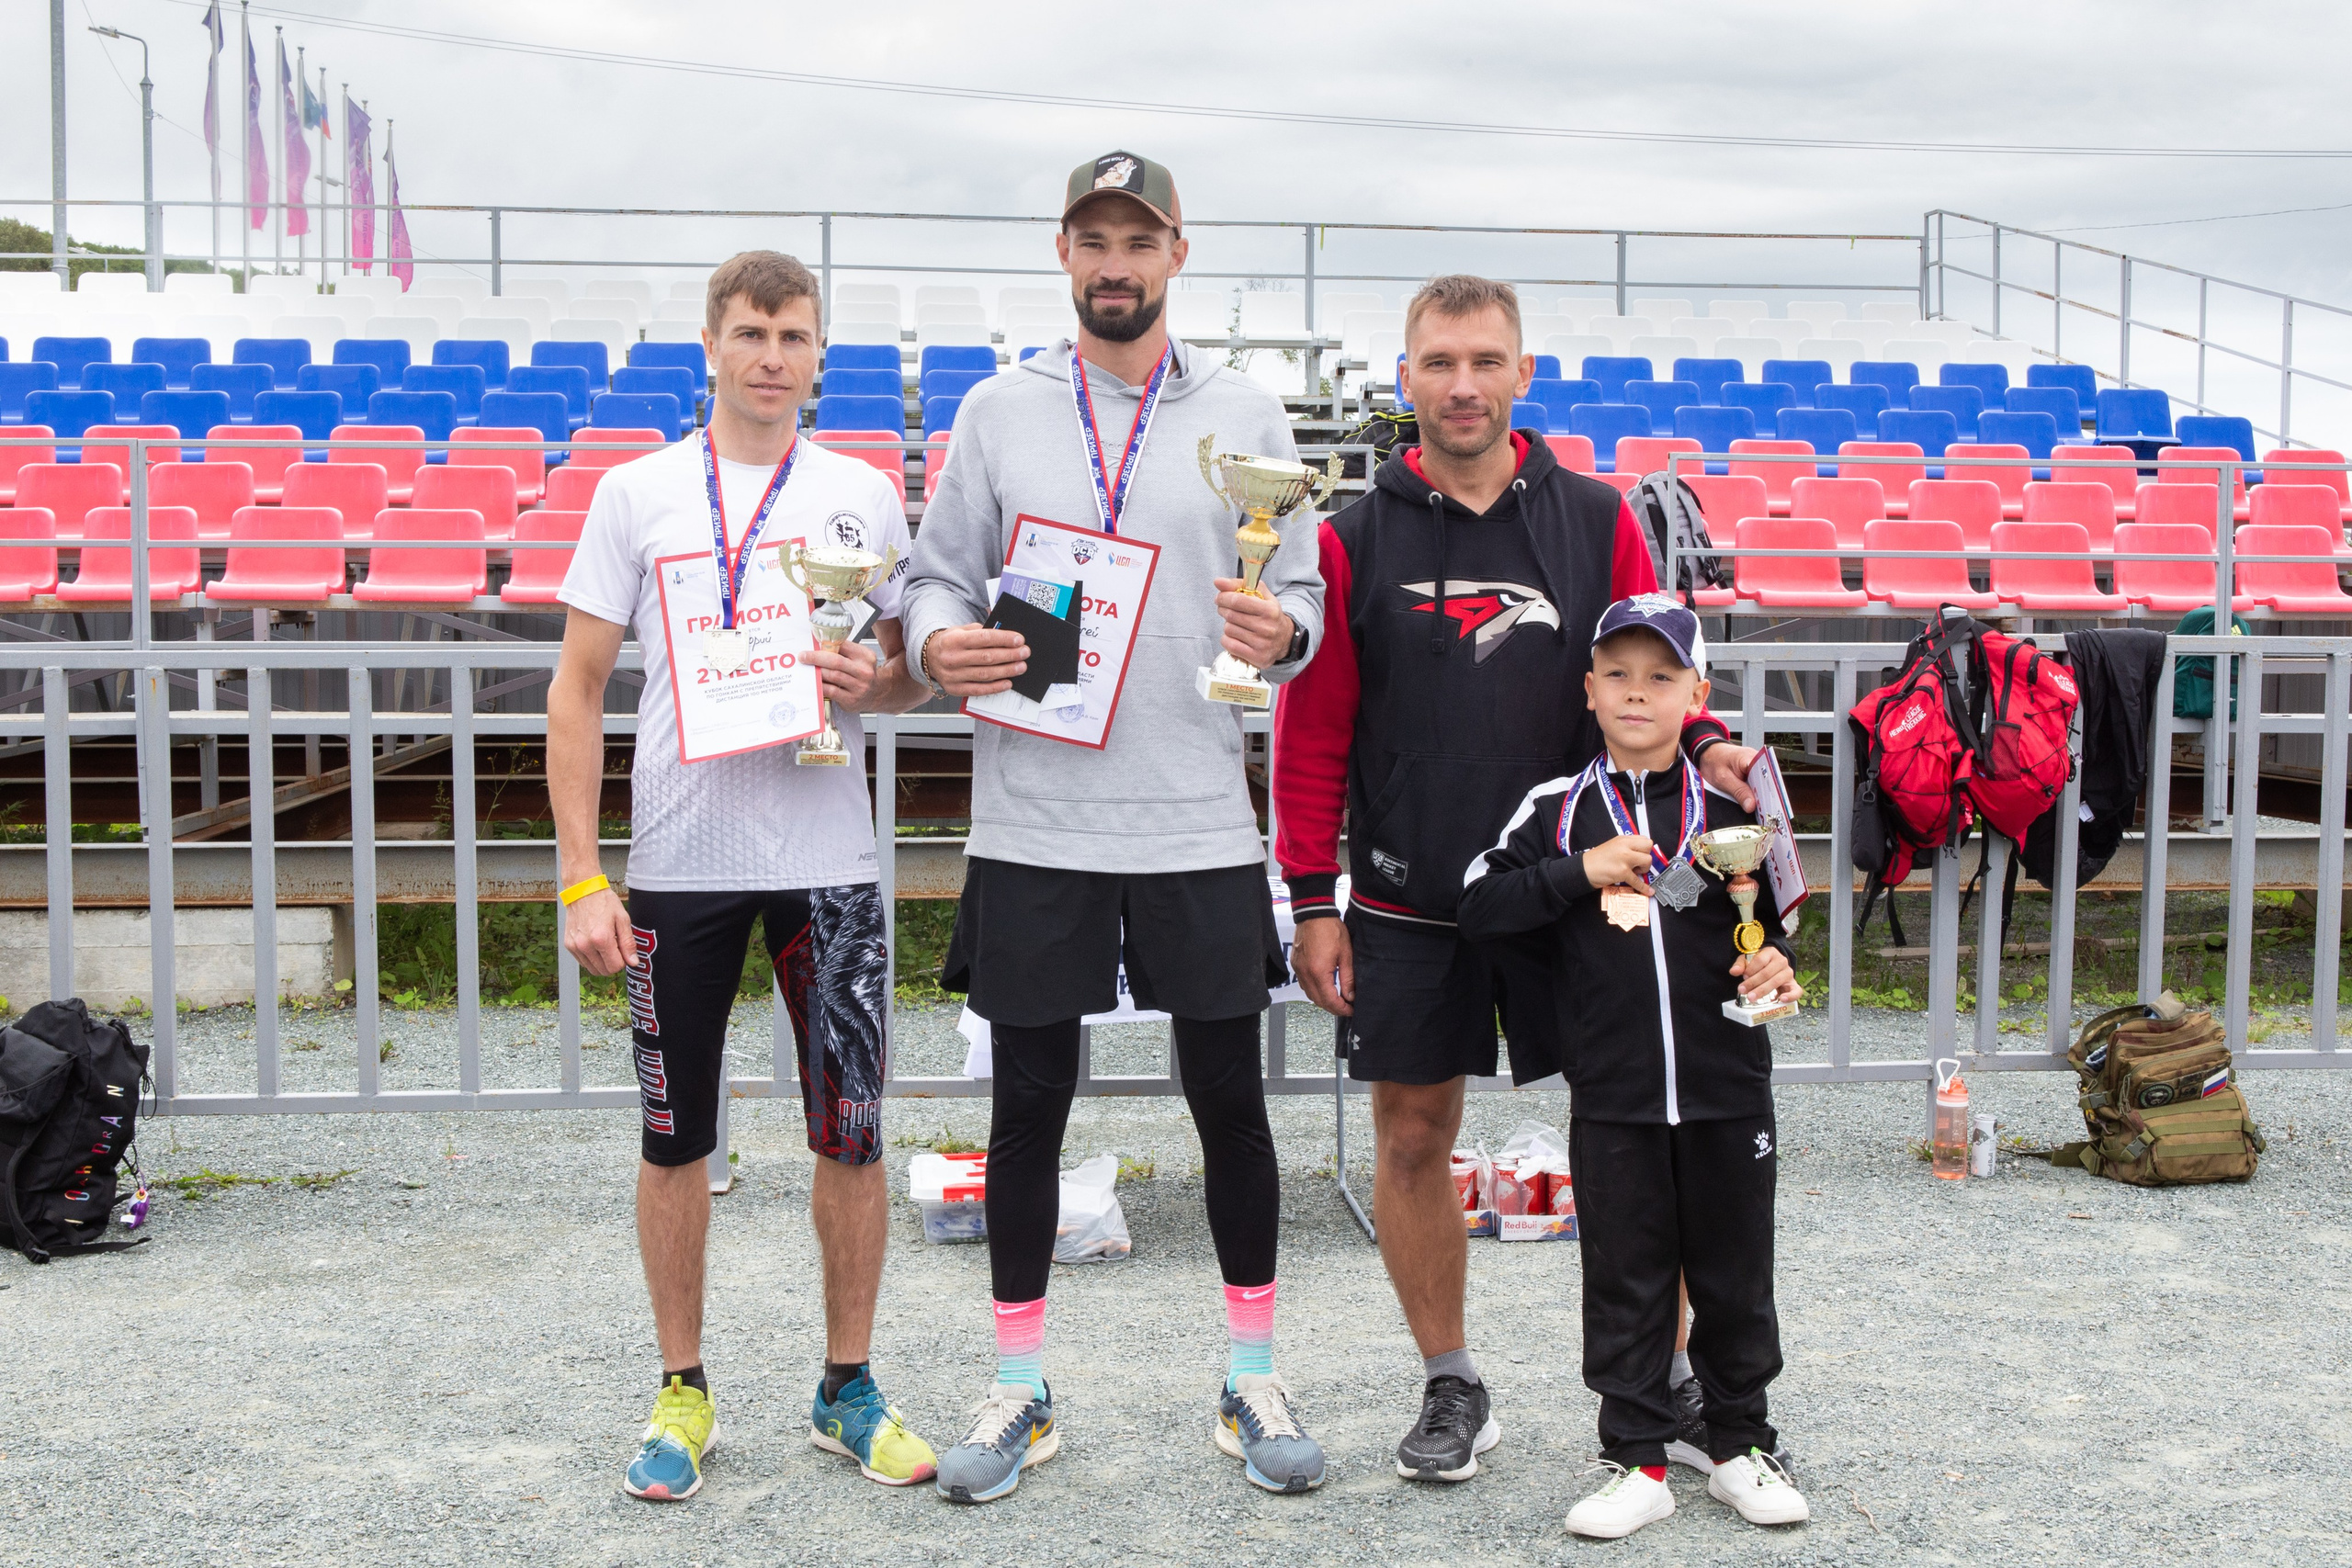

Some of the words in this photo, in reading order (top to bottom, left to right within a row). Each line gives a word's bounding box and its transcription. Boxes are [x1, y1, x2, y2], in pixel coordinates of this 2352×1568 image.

[1071, 364, 1083, 391] ПРИЗЕР
[1140, 392, 1155, 425] ПРИЗЕР
[1086, 427, 1098, 459] ПРИЗЕР
[705, 451, 714, 476] ПРИЗЕР
[1121, 452, 1136, 484] ПРИЗЕР
[763, 487, 779, 515] ПРИЗЕР
[1099, 487, 1111, 519] ПРИЗЕР
[712, 507, 723, 539] ПРИЗЕР
[740, 534, 756, 565] ПРИЗЕР
[1115, 555, 1131, 568] ЦСП
[719, 566, 730, 599] ПРИЗЕР
[696, 668, 710, 684] 2
[724, 679, 765, 691] САХАЛИНСКОЙ
[766, 674, 793, 683] ОБЛАСТИ
[1229, 684, 1254, 693] МЕСТО
[1889, 726, 1905, 738] HERO
[1905, 704, 1922, 723] LEAGUE
[1562, 801, 1572, 830] ПРИЗЕР
[1765, 1006, 1788, 1016] МЕСТО
[838, 1096, 882, 1138] ROGU
[1504, 1221, 1521, 1229] Red
[1521, 1221, 1537, 1229] Bull
